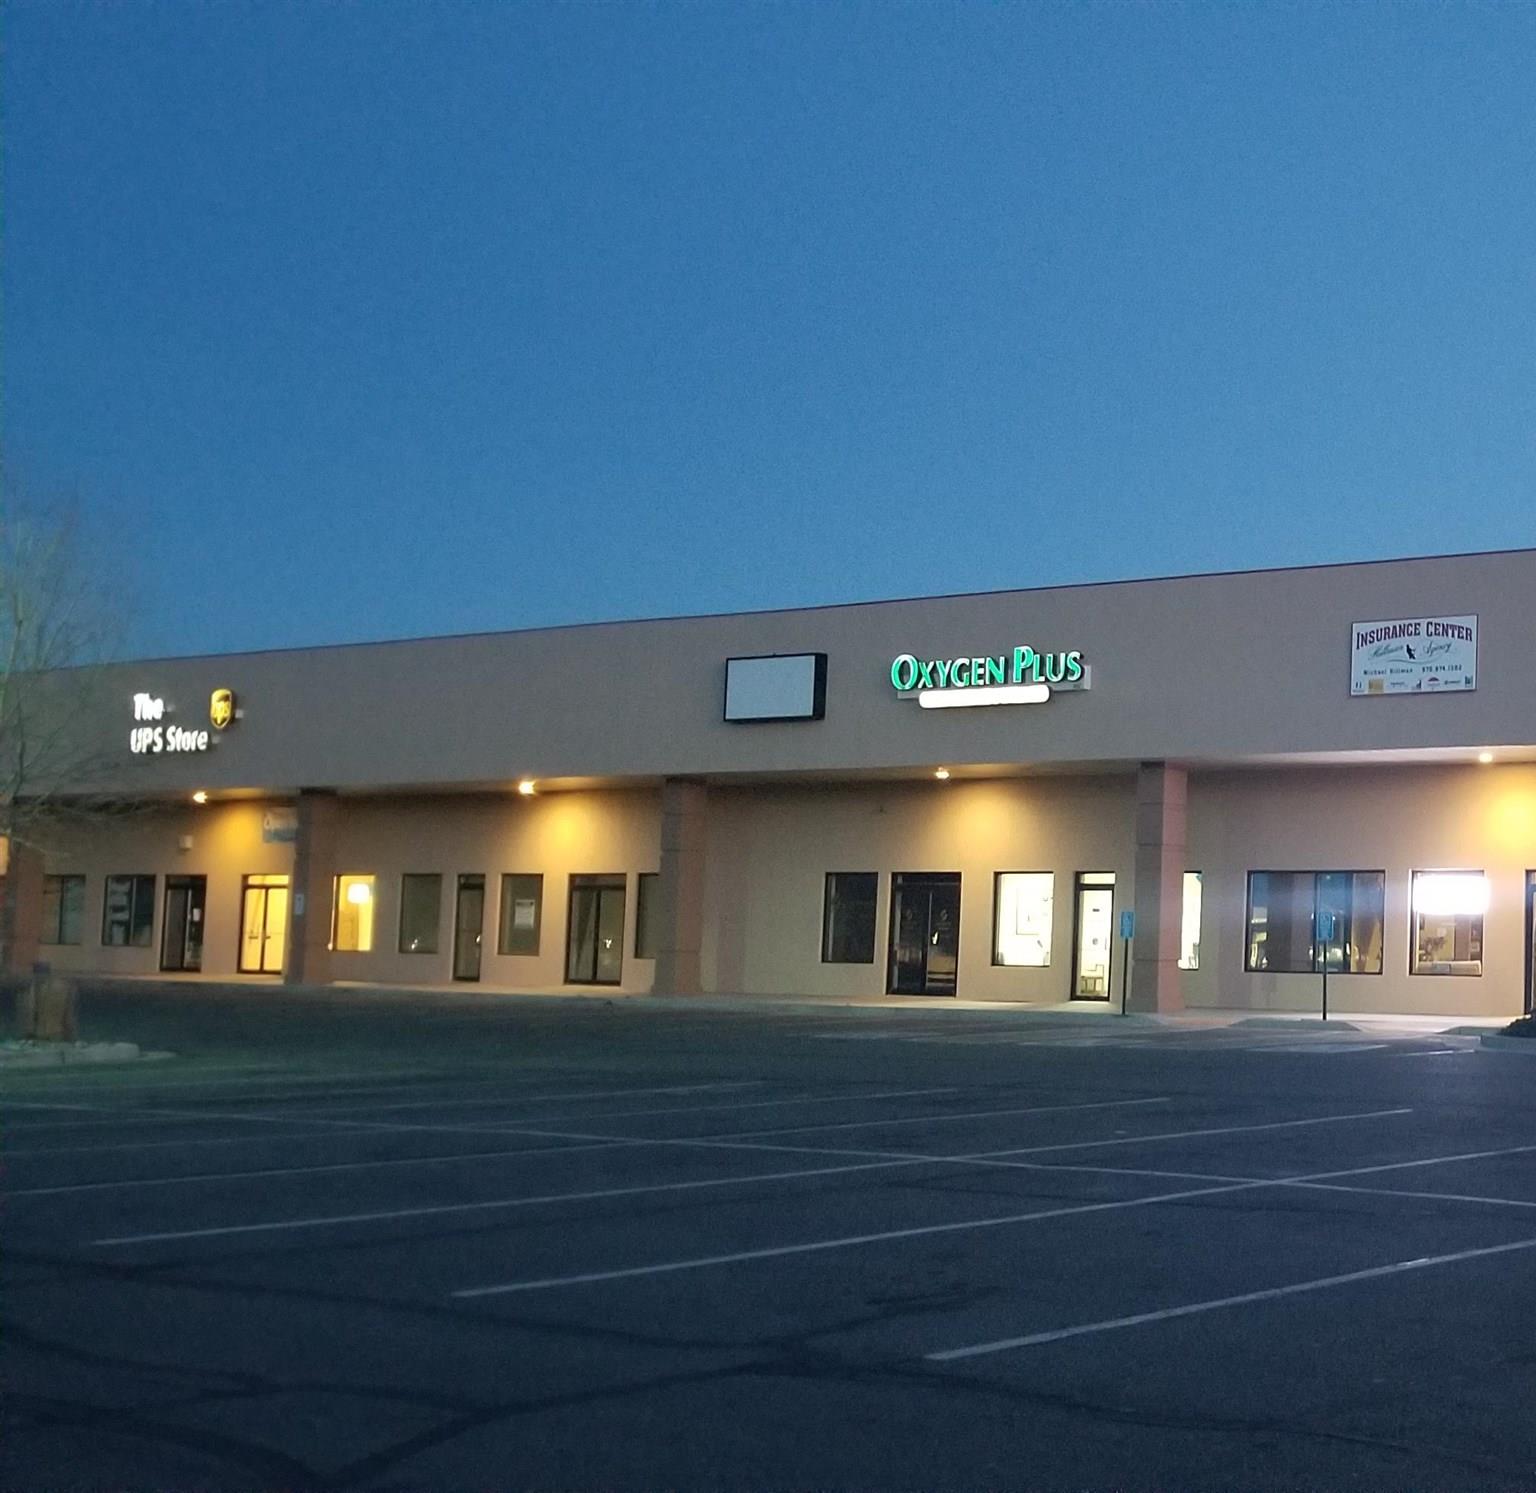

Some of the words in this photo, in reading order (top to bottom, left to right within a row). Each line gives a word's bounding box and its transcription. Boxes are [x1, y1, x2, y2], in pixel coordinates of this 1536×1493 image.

[1356, 622, 1421, 650] INSURANCE
[1426, 621, 1473, 641] CENTER
[890, 653, 1006, 691] OXYGEN
[1013, 644, 1083, 684] PLUS
[133, 692, 166, 721] The
[130, 726, 164, 754] UPS
[165, 725, 209, 752] Store
